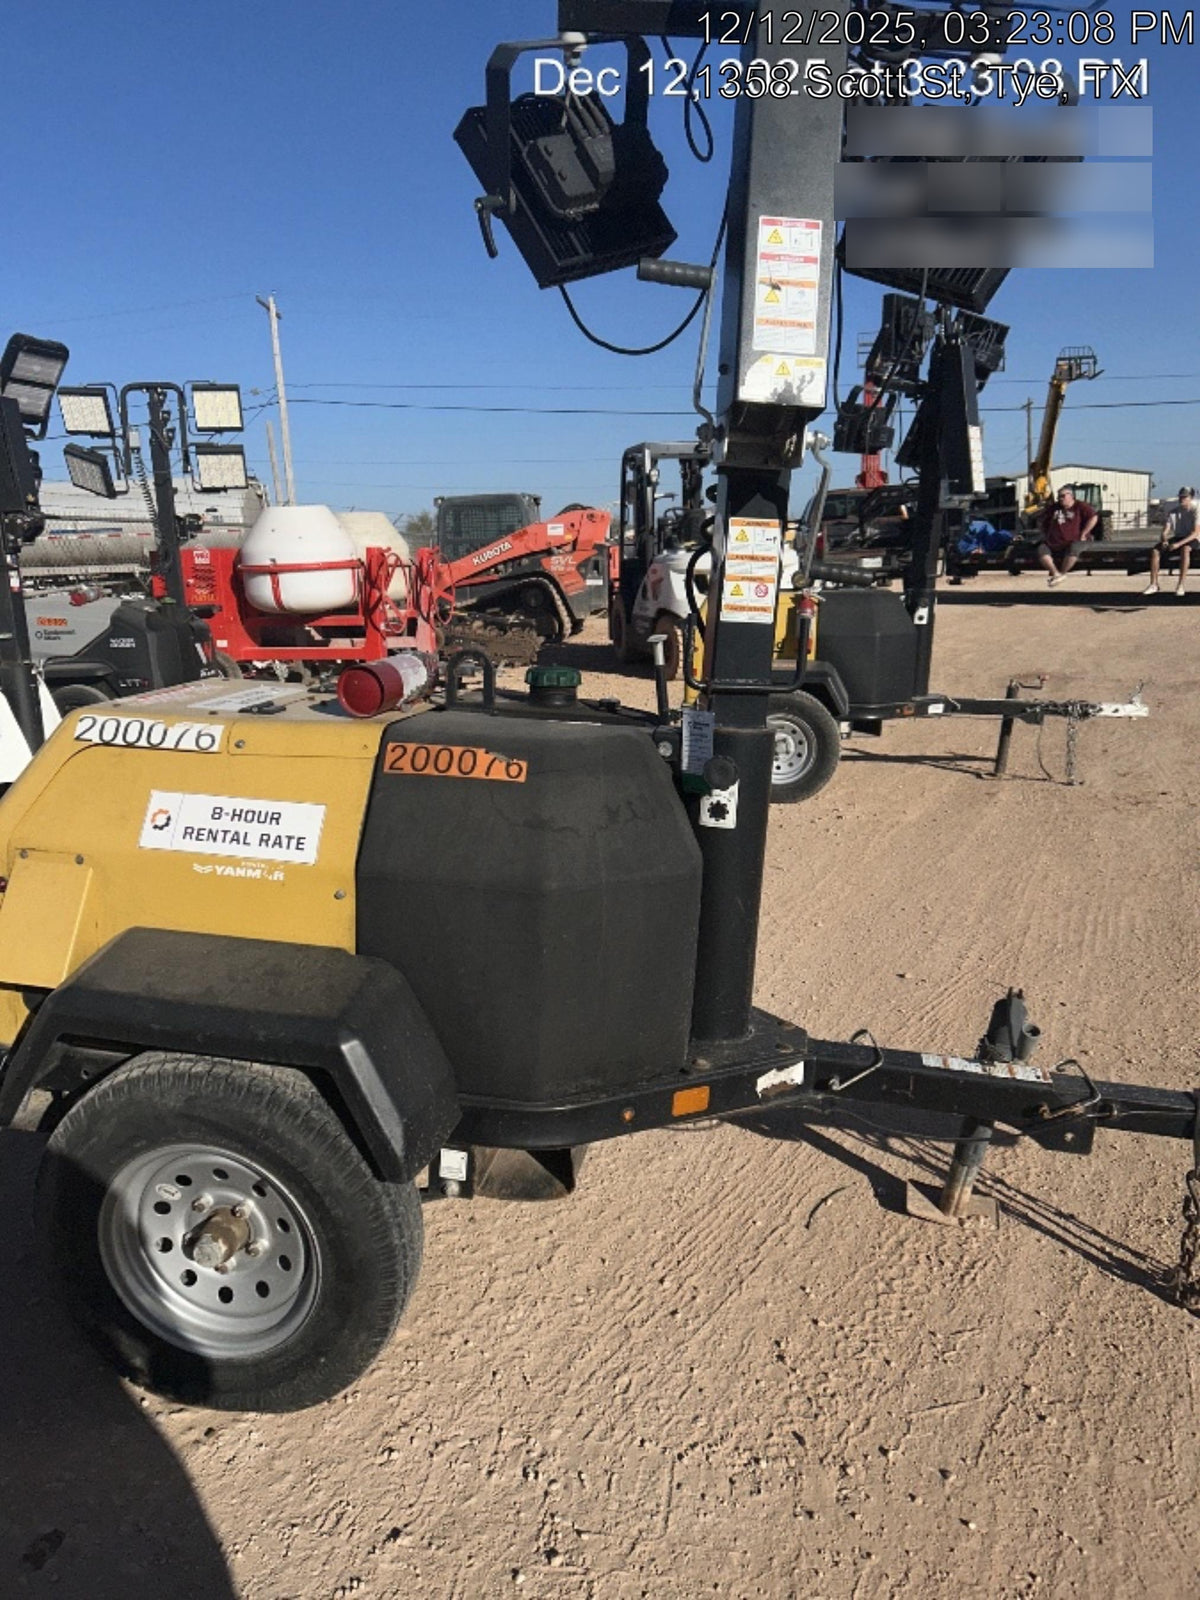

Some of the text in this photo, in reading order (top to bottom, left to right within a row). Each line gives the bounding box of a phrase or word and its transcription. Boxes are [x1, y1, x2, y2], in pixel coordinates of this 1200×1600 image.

[472, 541, 513, 566] KUBOTA
[210, 806, 282, 826] 8-HOUR
[181, 825, 307, 851] RENTAL RATE
